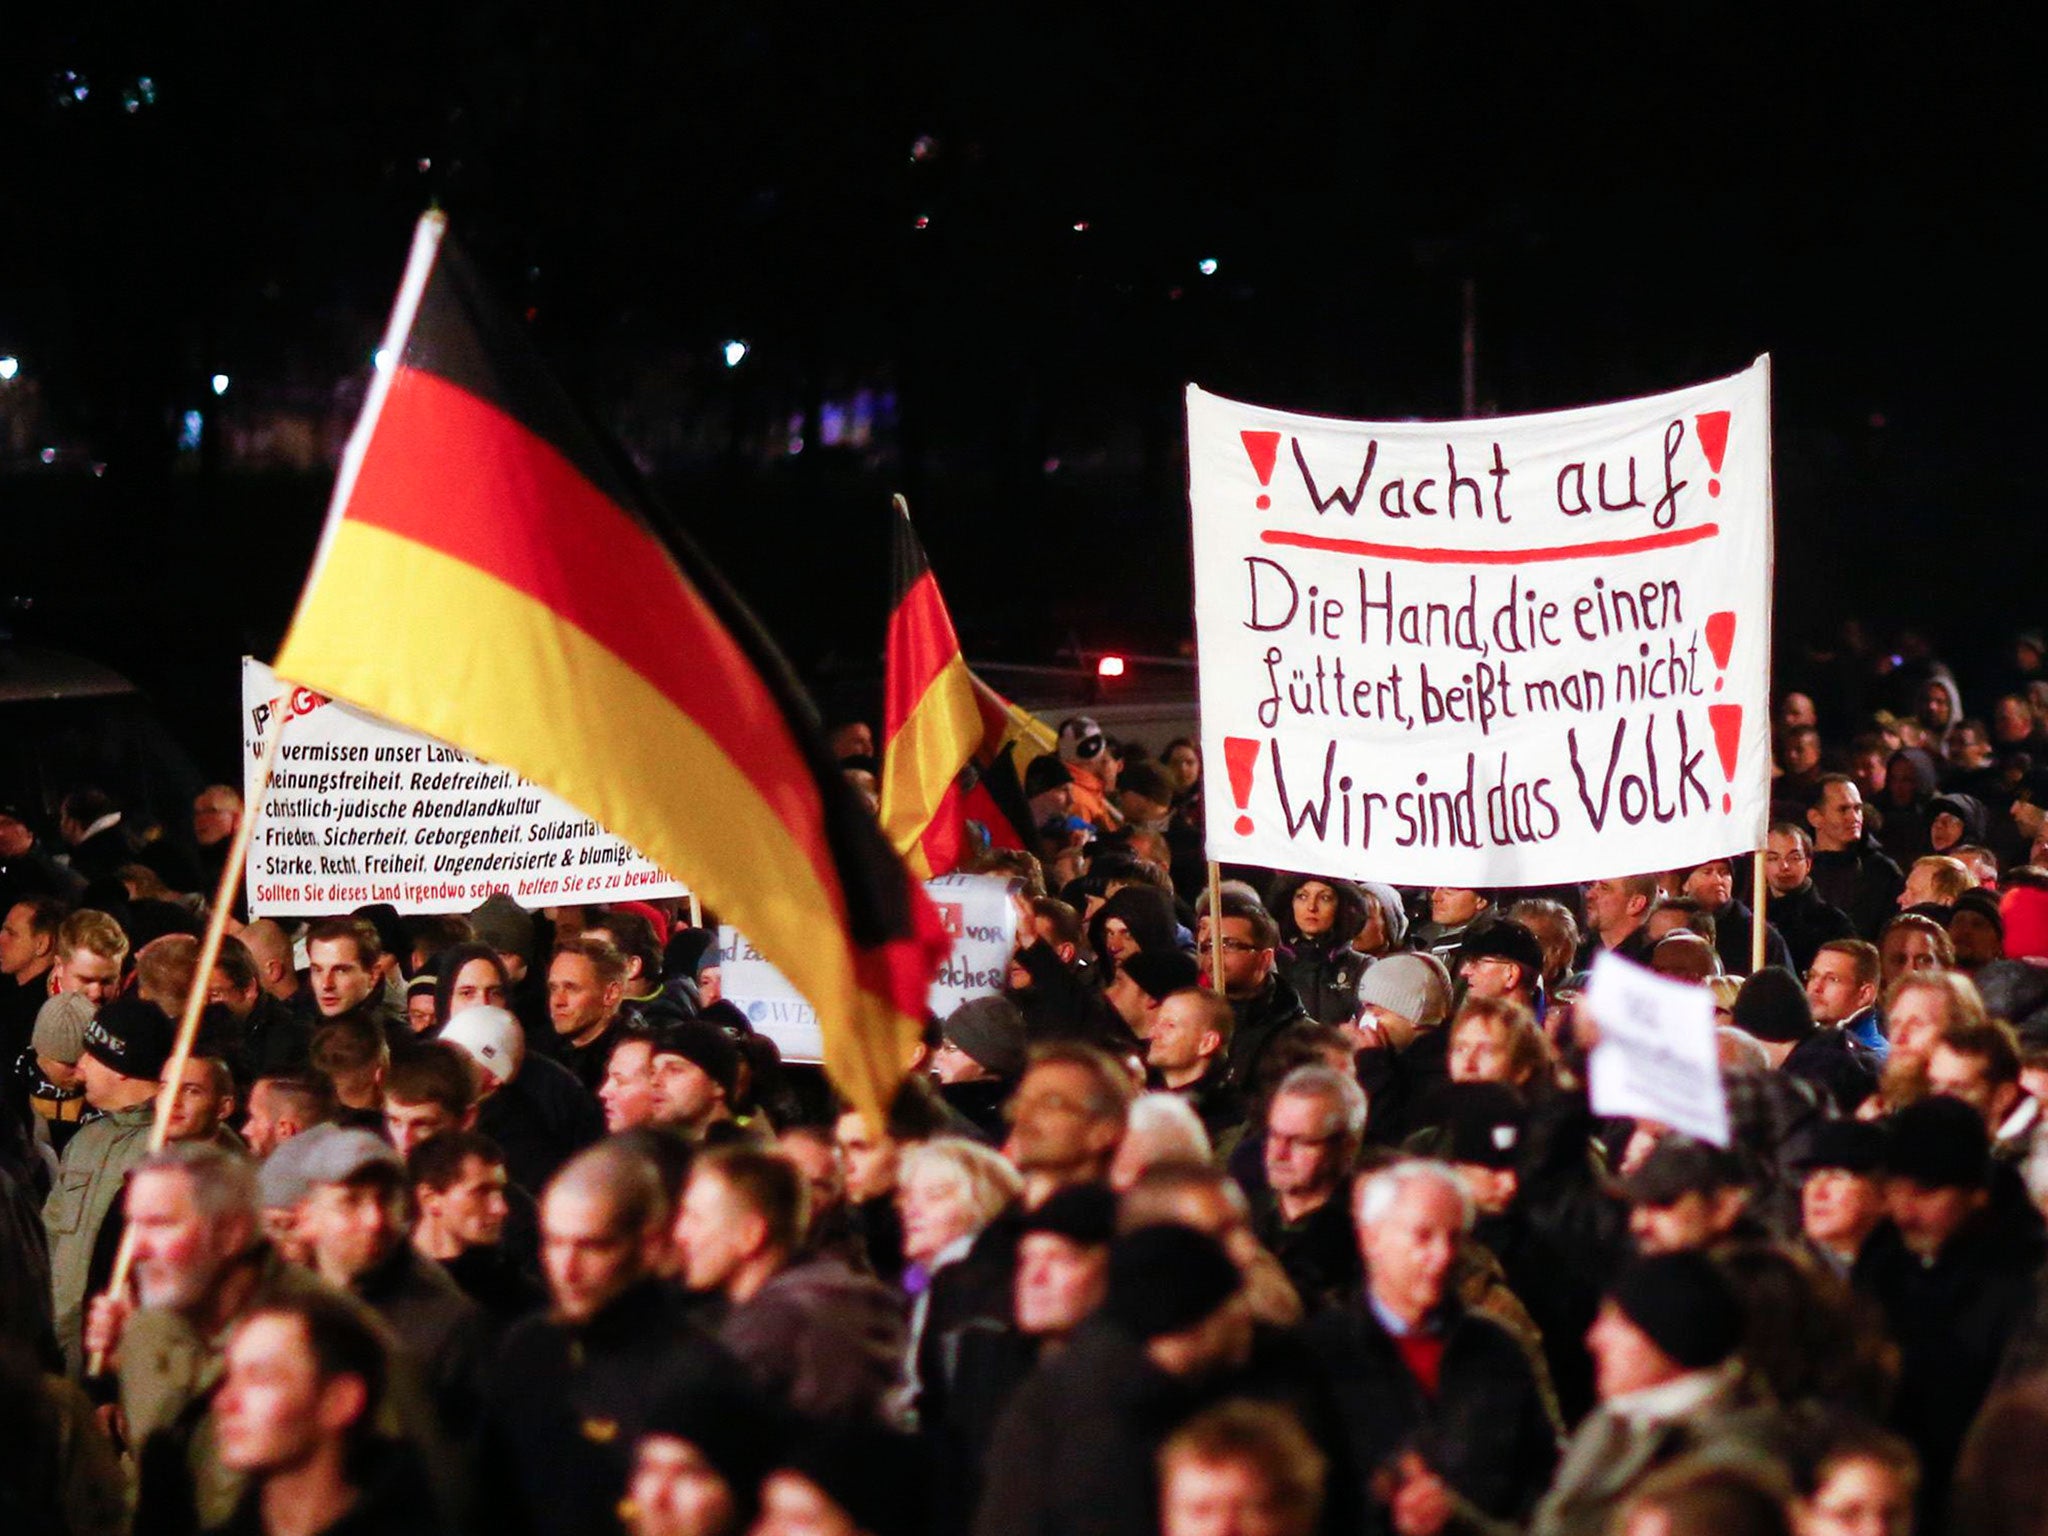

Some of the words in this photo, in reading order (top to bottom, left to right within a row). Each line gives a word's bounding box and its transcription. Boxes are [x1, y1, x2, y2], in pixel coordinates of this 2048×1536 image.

[1243, 556, 1344, 639] Die
[1493, 575, 1561, 653] die
[1574, 577, 1682, 641] einen
[1420, 660, 1516, 735] beißt
[1524, 669, 1604, 712] man
[281, 741, 369, 761] vermissen
[375, 746, 422, 762] unser
[411, 797, 541, 818] Abendlandkultur
[1271, 738, 1388, 849] Wir
[1395, 752, 1483, 849] sind
[1487, 752, 1560, 846] das
[433, 850, 557, 876] Ungenderisierte
[561, 848, 575, 867] &
[579, 842, 633, 867] blumige
[256, 884, 300, 902] Sollten
[304, 882, 325, 902] Sie
[328, 883, 368, 902] dieses
[371, 882, 401, 901] Land
[404, 881, 466, 904] irgendwo
[517, 877, 558, 896] helfen
[561, 874, 583, 893] Sie
[586, 875, 602, 891] es
[605, 874, 622, 889] zu
